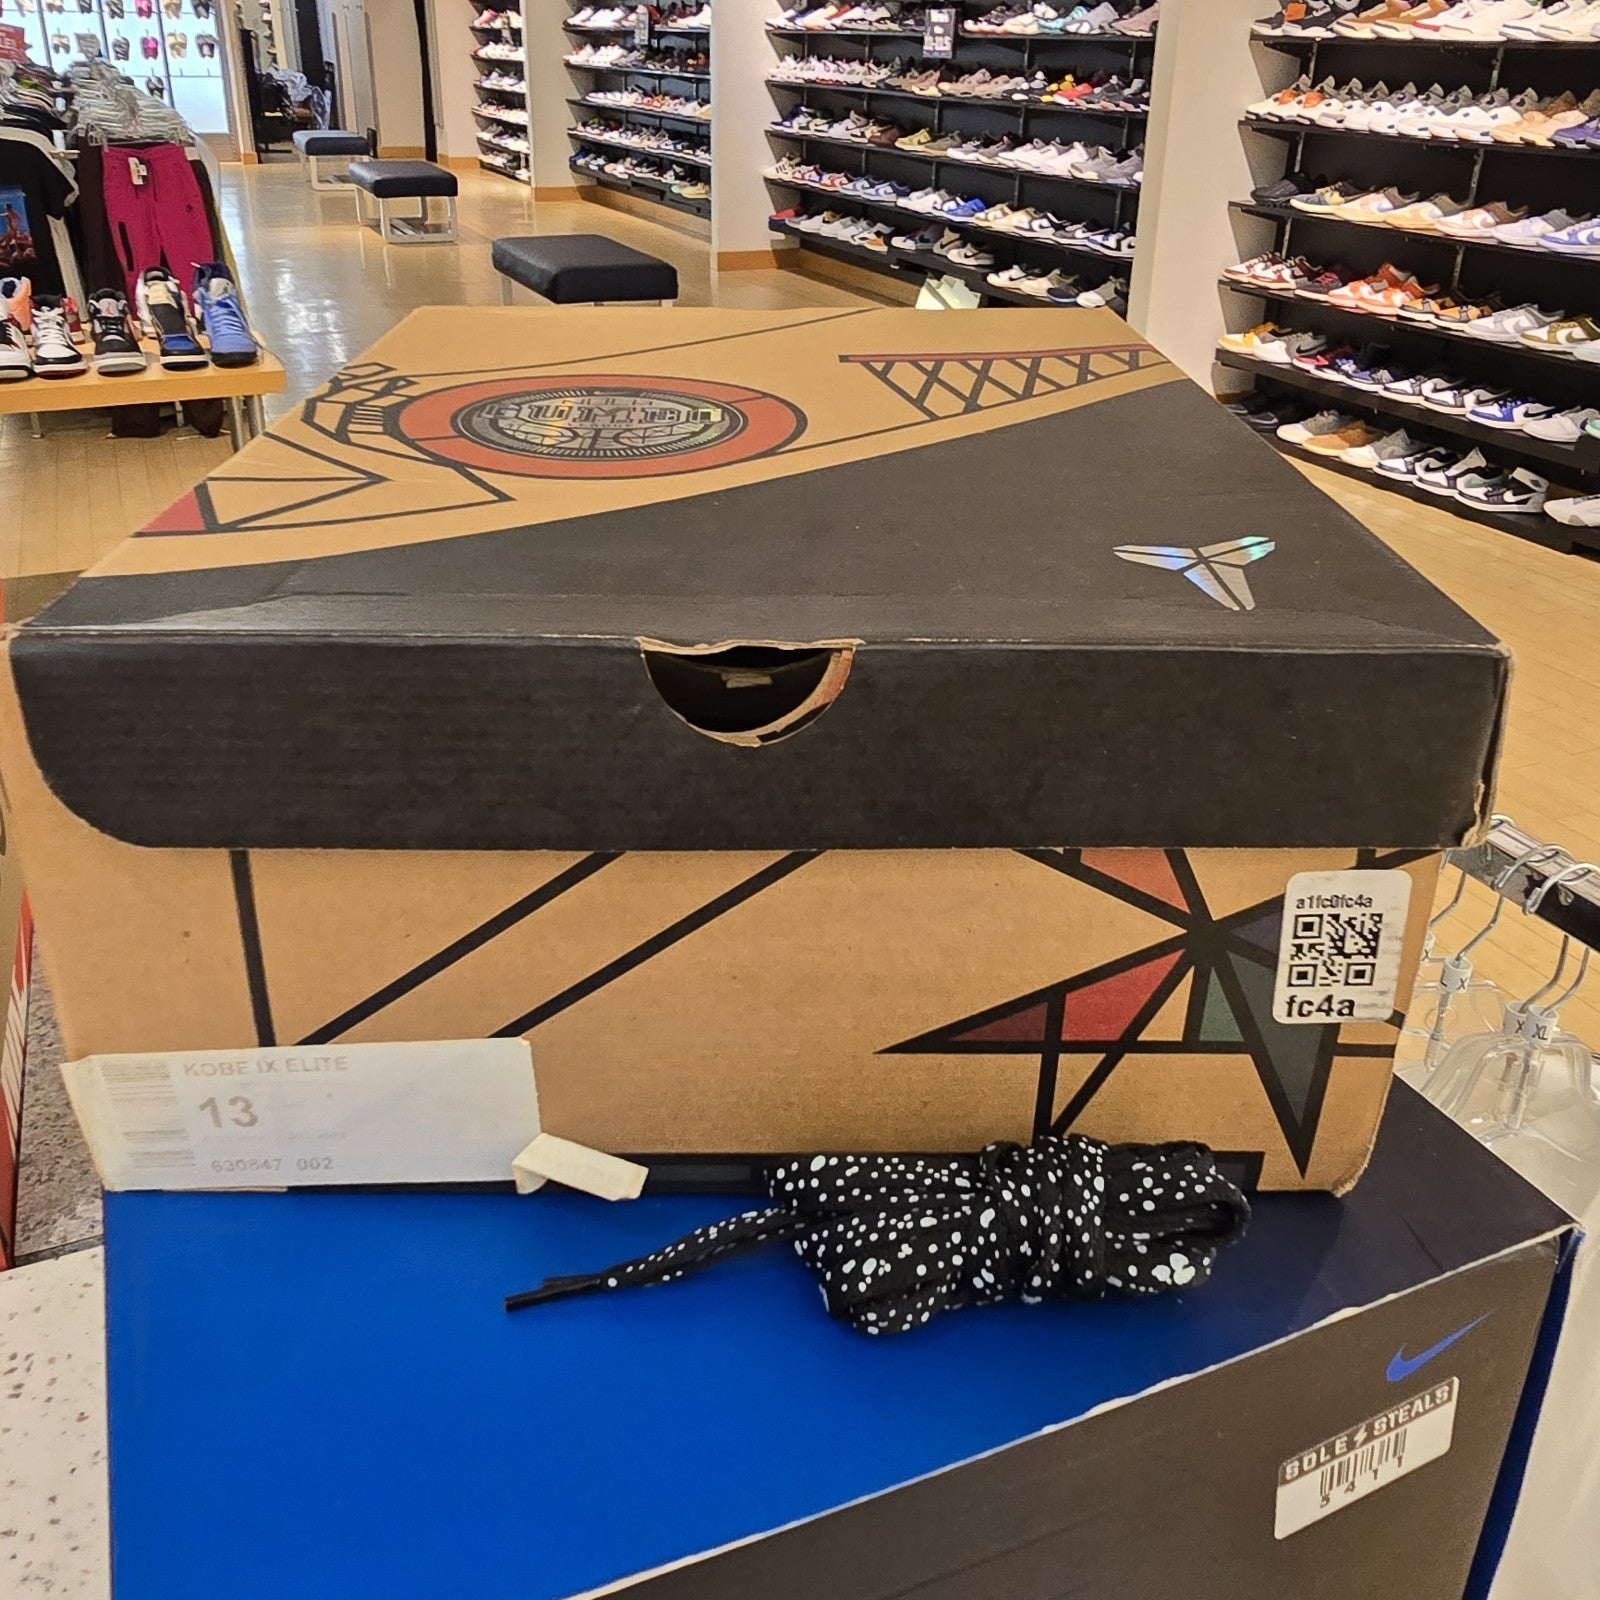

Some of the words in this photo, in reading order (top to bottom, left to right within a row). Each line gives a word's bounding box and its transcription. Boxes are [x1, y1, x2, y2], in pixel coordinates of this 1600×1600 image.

[1285, 994, 1356, 1018] fc4a
[1531, 1023, 1548, 1040] XL
[183, 1060, 248, 1077] KOBE
[257, 1059, 279, 1074] IX
[286, 1056, 349, 1073] ELITE
[199, 1095, 258, 1128] 13
[210, 1158, 282, 1173] 630847
[1285, 1435, 1348, 1481] SOLE
[1373, 1385, 1450, 1436] STEALS
